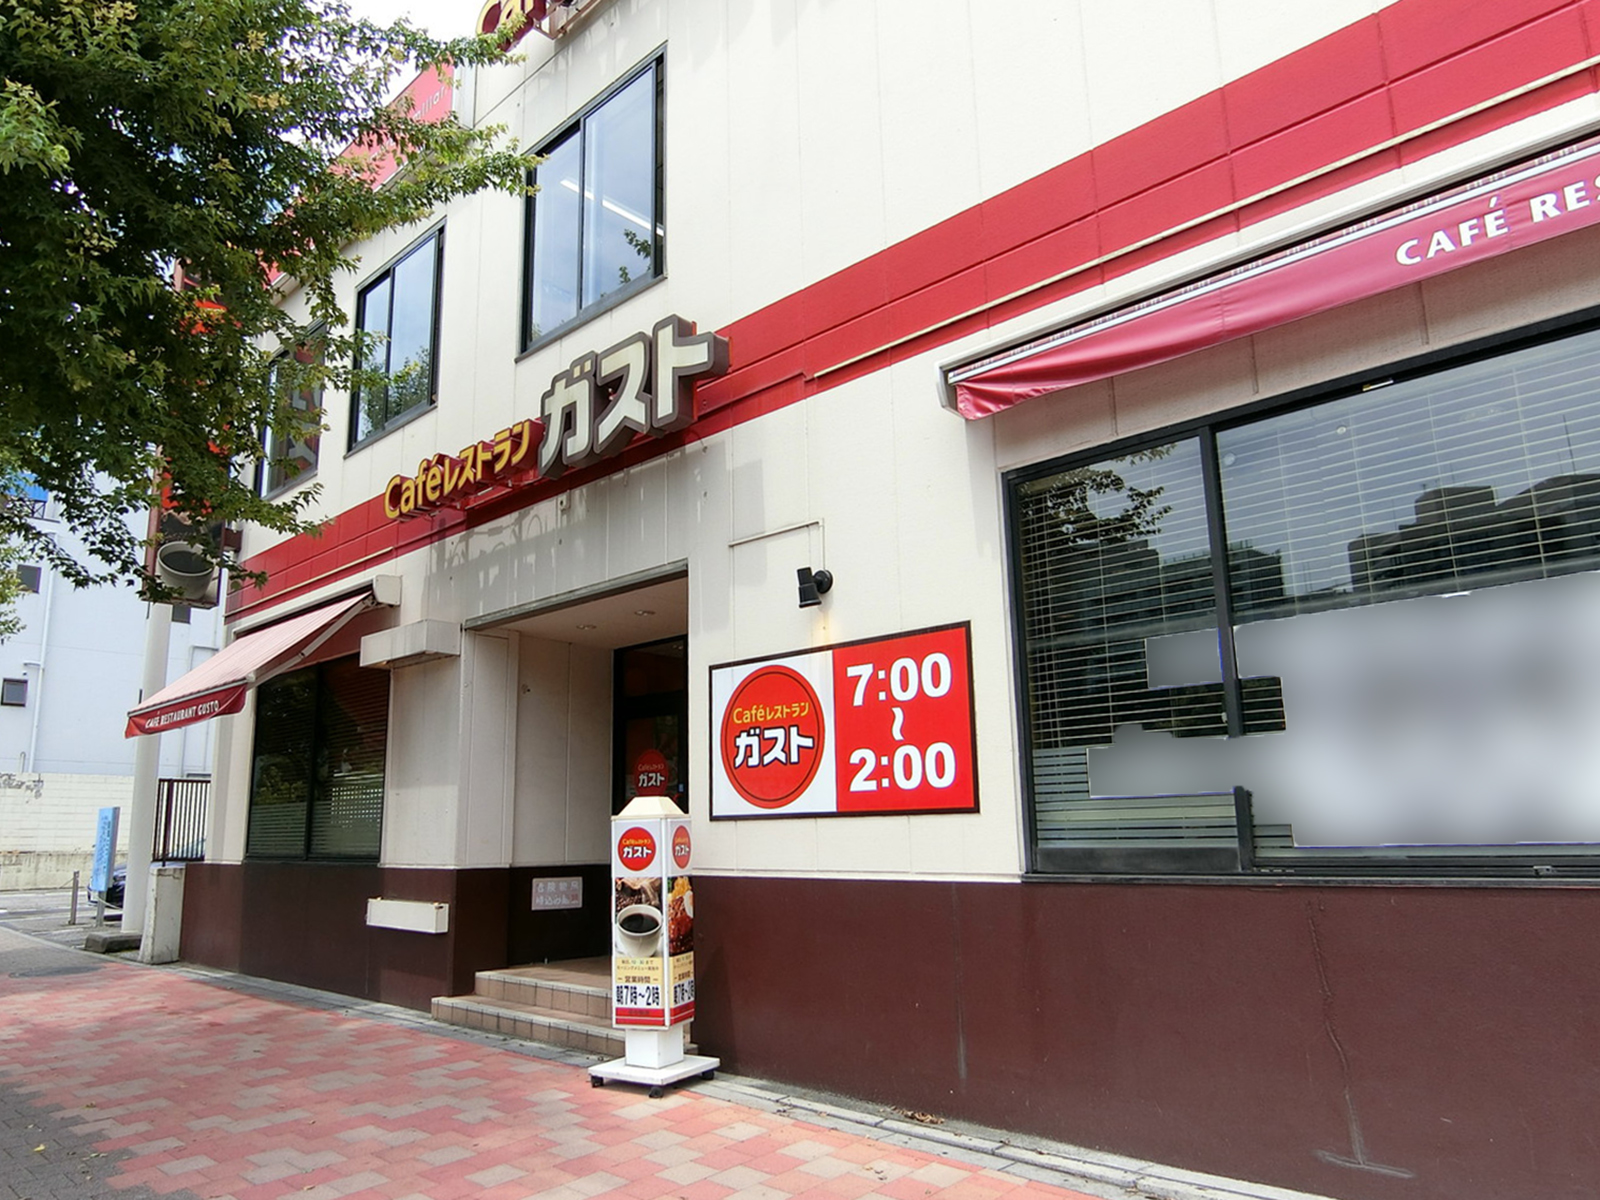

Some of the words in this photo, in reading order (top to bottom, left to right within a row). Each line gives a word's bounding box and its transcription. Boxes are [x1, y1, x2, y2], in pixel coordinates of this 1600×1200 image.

[1396, 197, 1508, 265] CAFÉ
[1529, 174, 1600, 223] RE
[384, 419, 531, 519] Caféレストラン
[538, 318, 714, 471] ガスト
[846, 652, 953, 707] 7:00
[160, 706, 197, 725] RESTAURANT
[197, 700, 219, 715] GUSTO
[732, 702, 810, 725] Caféレストラン
[734, 725, 814, 769] ガスト
[849, 742, 957, 792] 2:00
[638, 772, 665, 788] ガスト
[622, 845, 652, 859] ガスト
